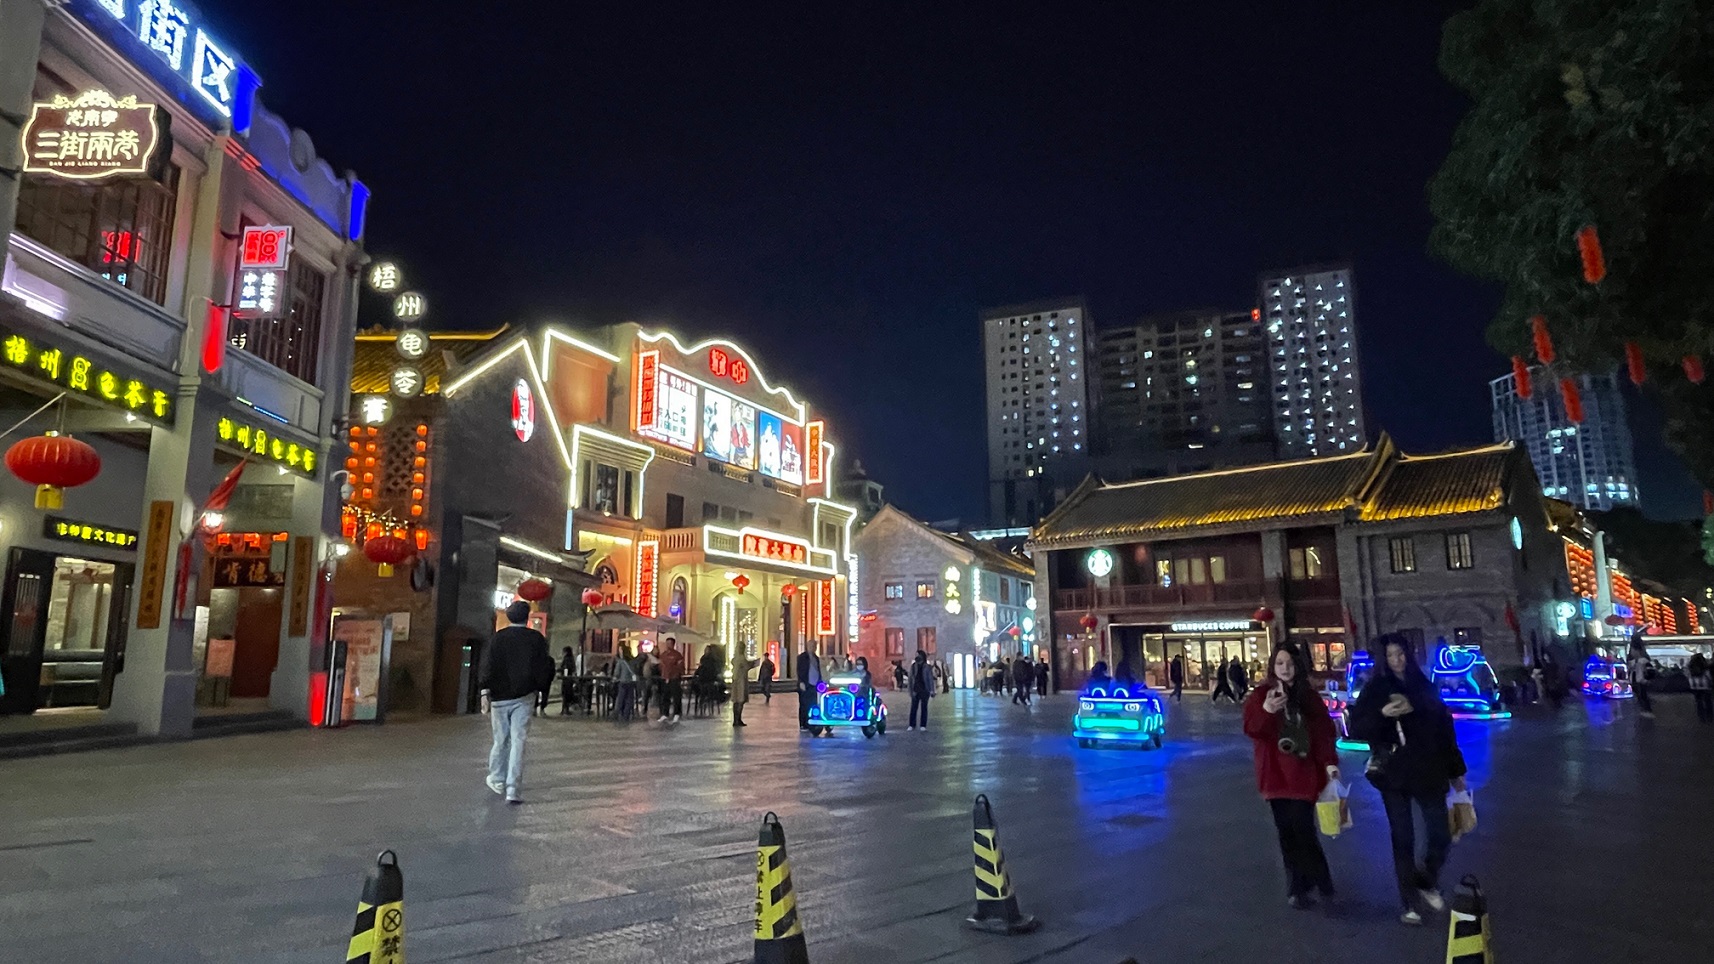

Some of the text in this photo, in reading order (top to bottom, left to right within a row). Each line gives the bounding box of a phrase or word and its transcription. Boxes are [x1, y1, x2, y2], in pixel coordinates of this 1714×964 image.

[1171, 621, 1250, 631] STARBUCKS COFFEE
[381, 934, 401, 964] 禁
